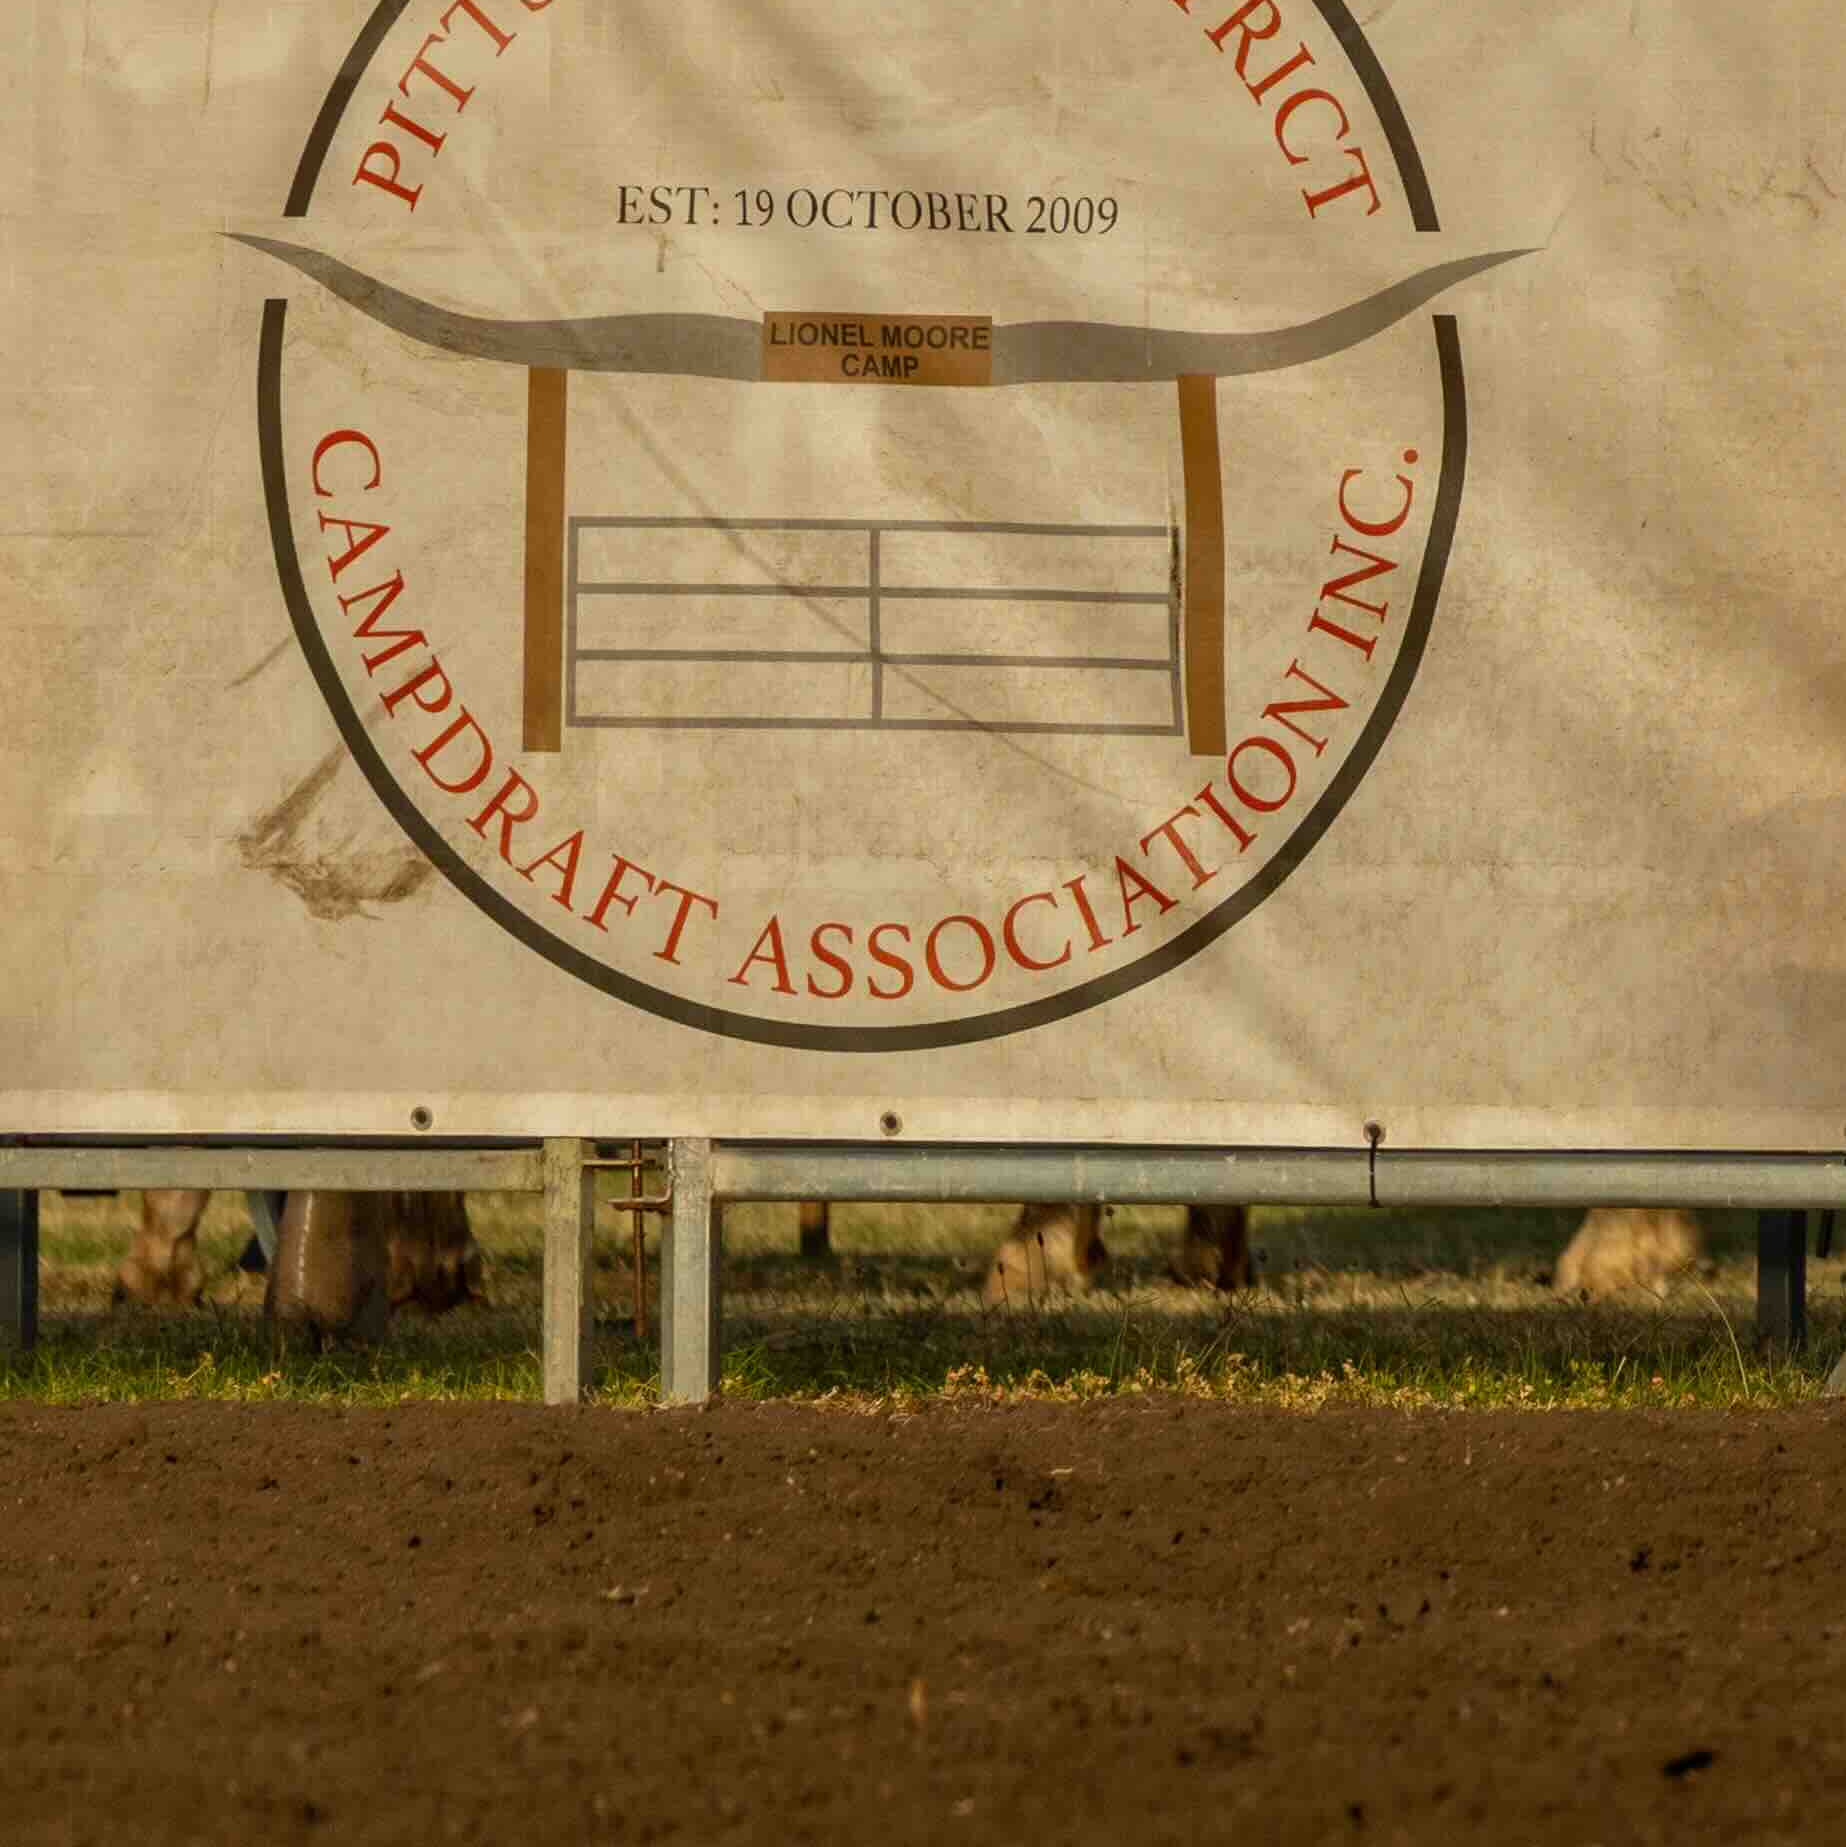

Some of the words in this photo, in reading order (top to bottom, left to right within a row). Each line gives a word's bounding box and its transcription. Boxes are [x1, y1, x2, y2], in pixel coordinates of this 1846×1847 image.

[617, 185, 721, 229] EST:
[734, 189, 775, 229] 19
[786, 188, 1014, 235] OCTOBER
[1025, 194, 1120, 236] 2009
[770, 321, 876, 349] LIONEL
[880, 322, 991, 352] MOORE
[840, 353, 919, 379] CAMP
[310, 430, 718, 966] CAMPDRAFT
[729, 660, 1352, 999] ASSOCIATION
[1311, 448, 1420, 659] INC.
